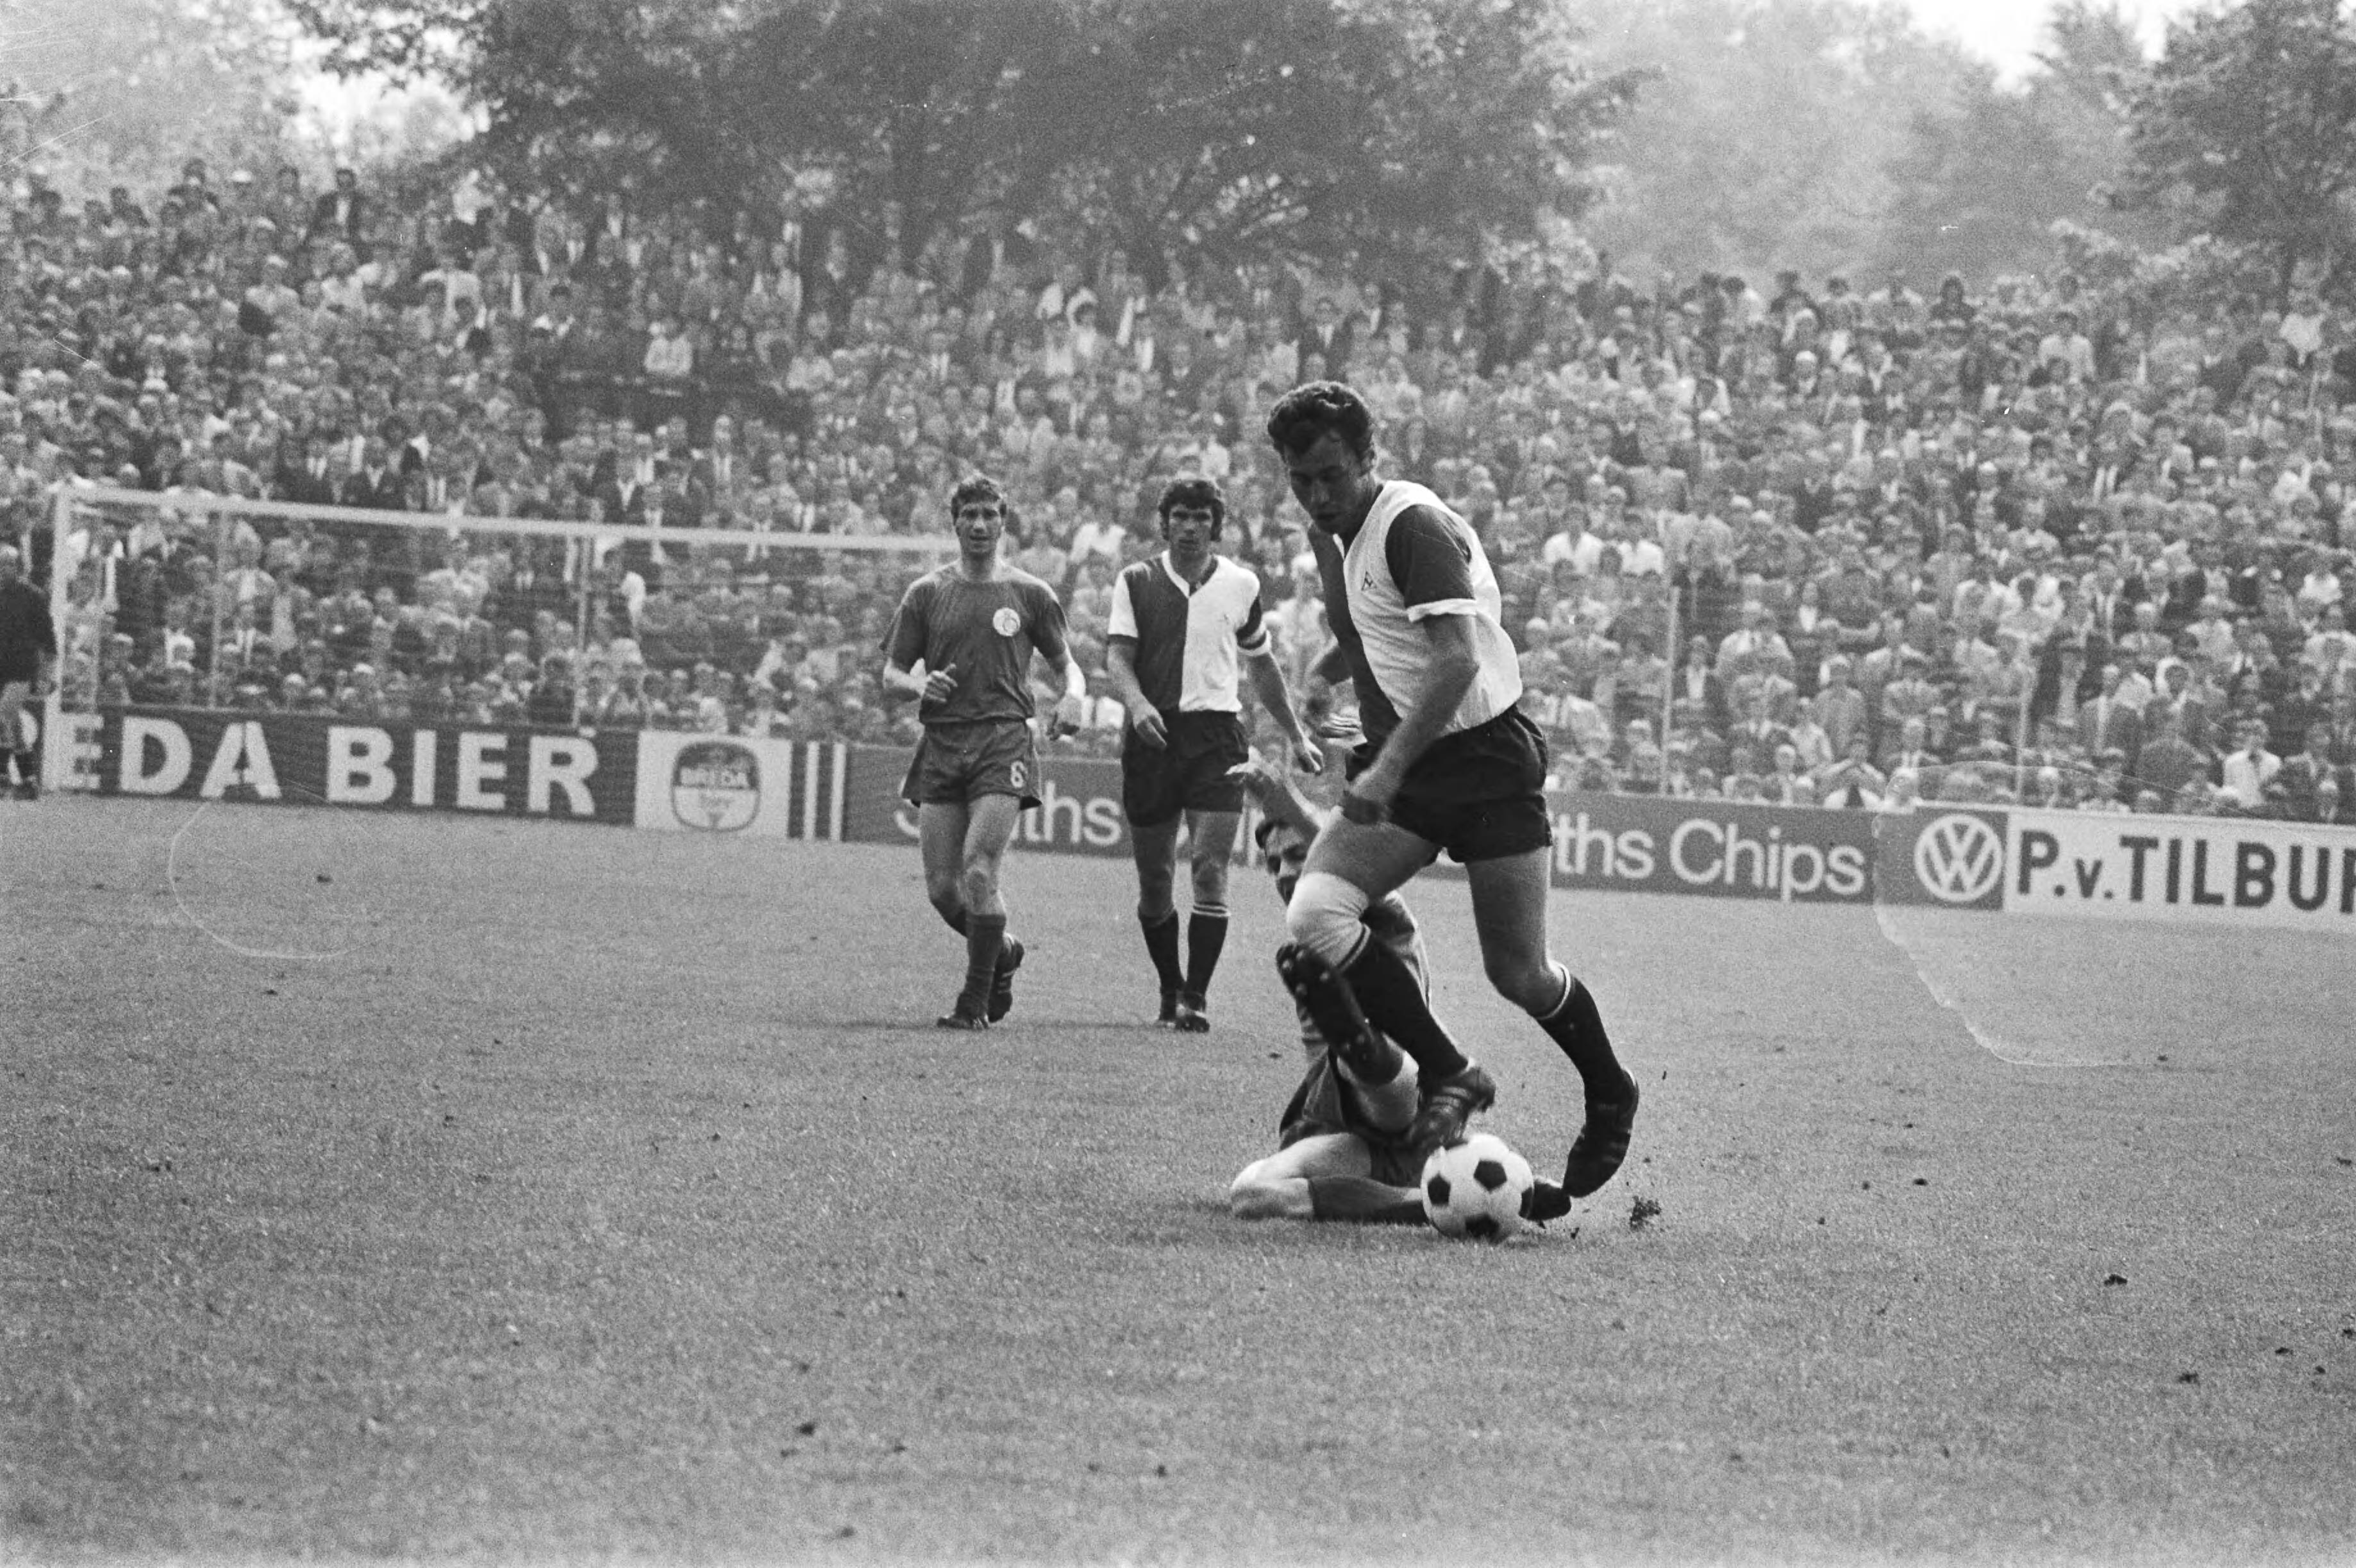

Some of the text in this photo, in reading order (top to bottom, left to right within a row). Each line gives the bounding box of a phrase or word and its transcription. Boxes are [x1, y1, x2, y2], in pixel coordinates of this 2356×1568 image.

[327, 724, 598, 816] BIER
[1547, 812, 1865, 901] ths Chips
